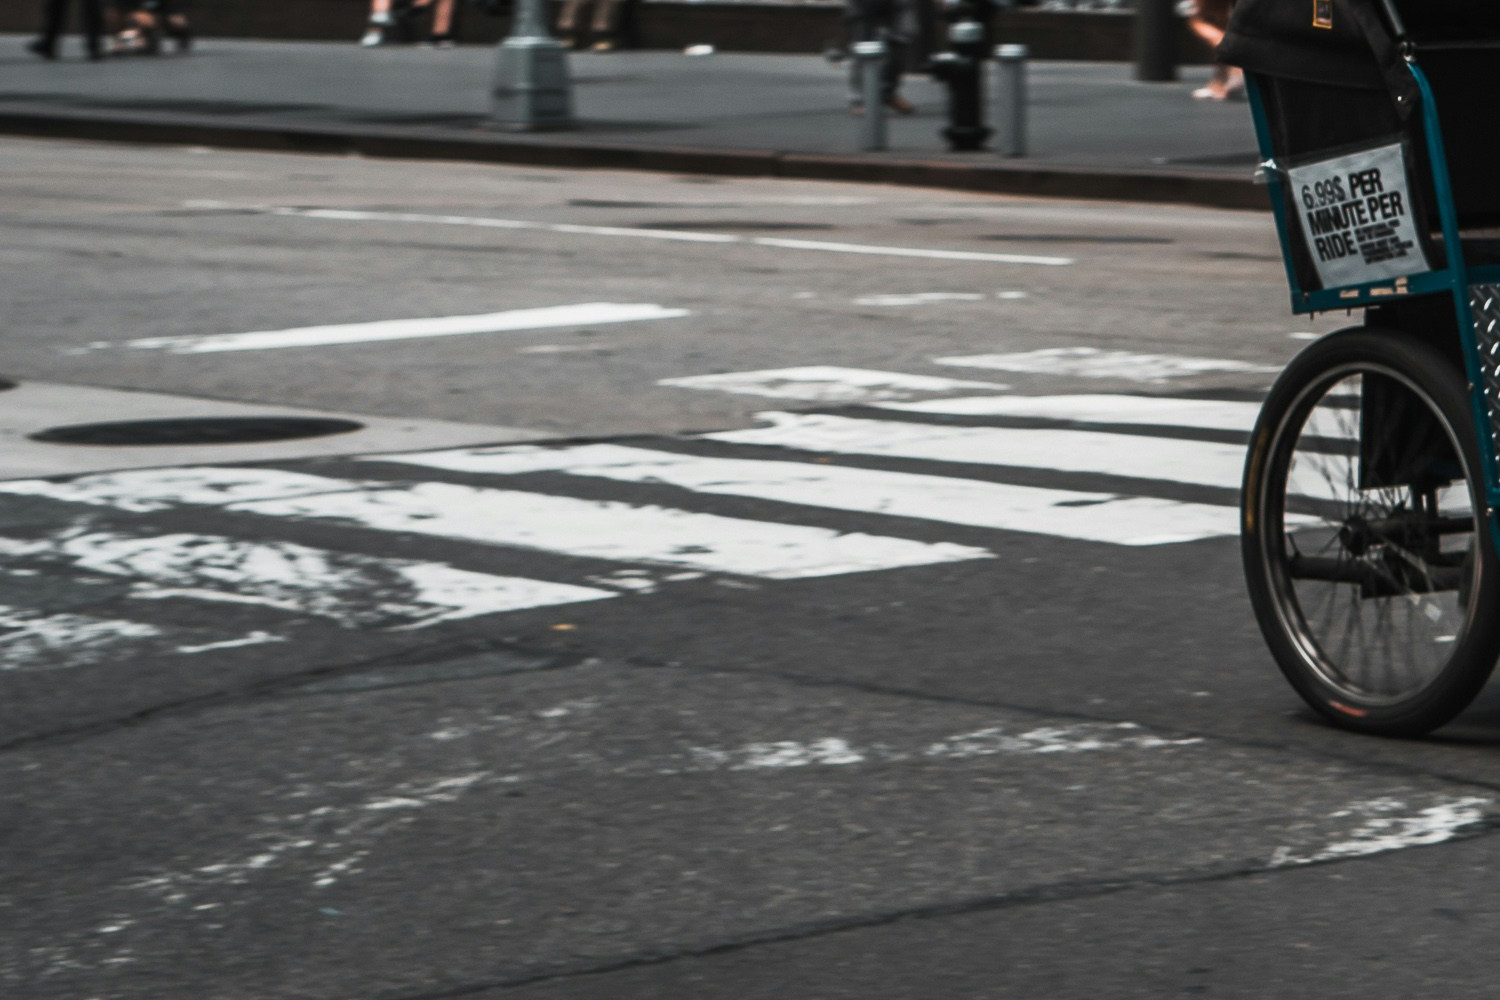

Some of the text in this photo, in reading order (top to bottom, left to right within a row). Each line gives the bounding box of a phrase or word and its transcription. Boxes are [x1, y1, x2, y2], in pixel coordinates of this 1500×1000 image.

[1348, 167, 1383, 199] PER
[1307, 200, 1369, 236] MINUTE
[1367, 191, 1404, 222] PER
[1315, 230, 1358, 262] RIDE
